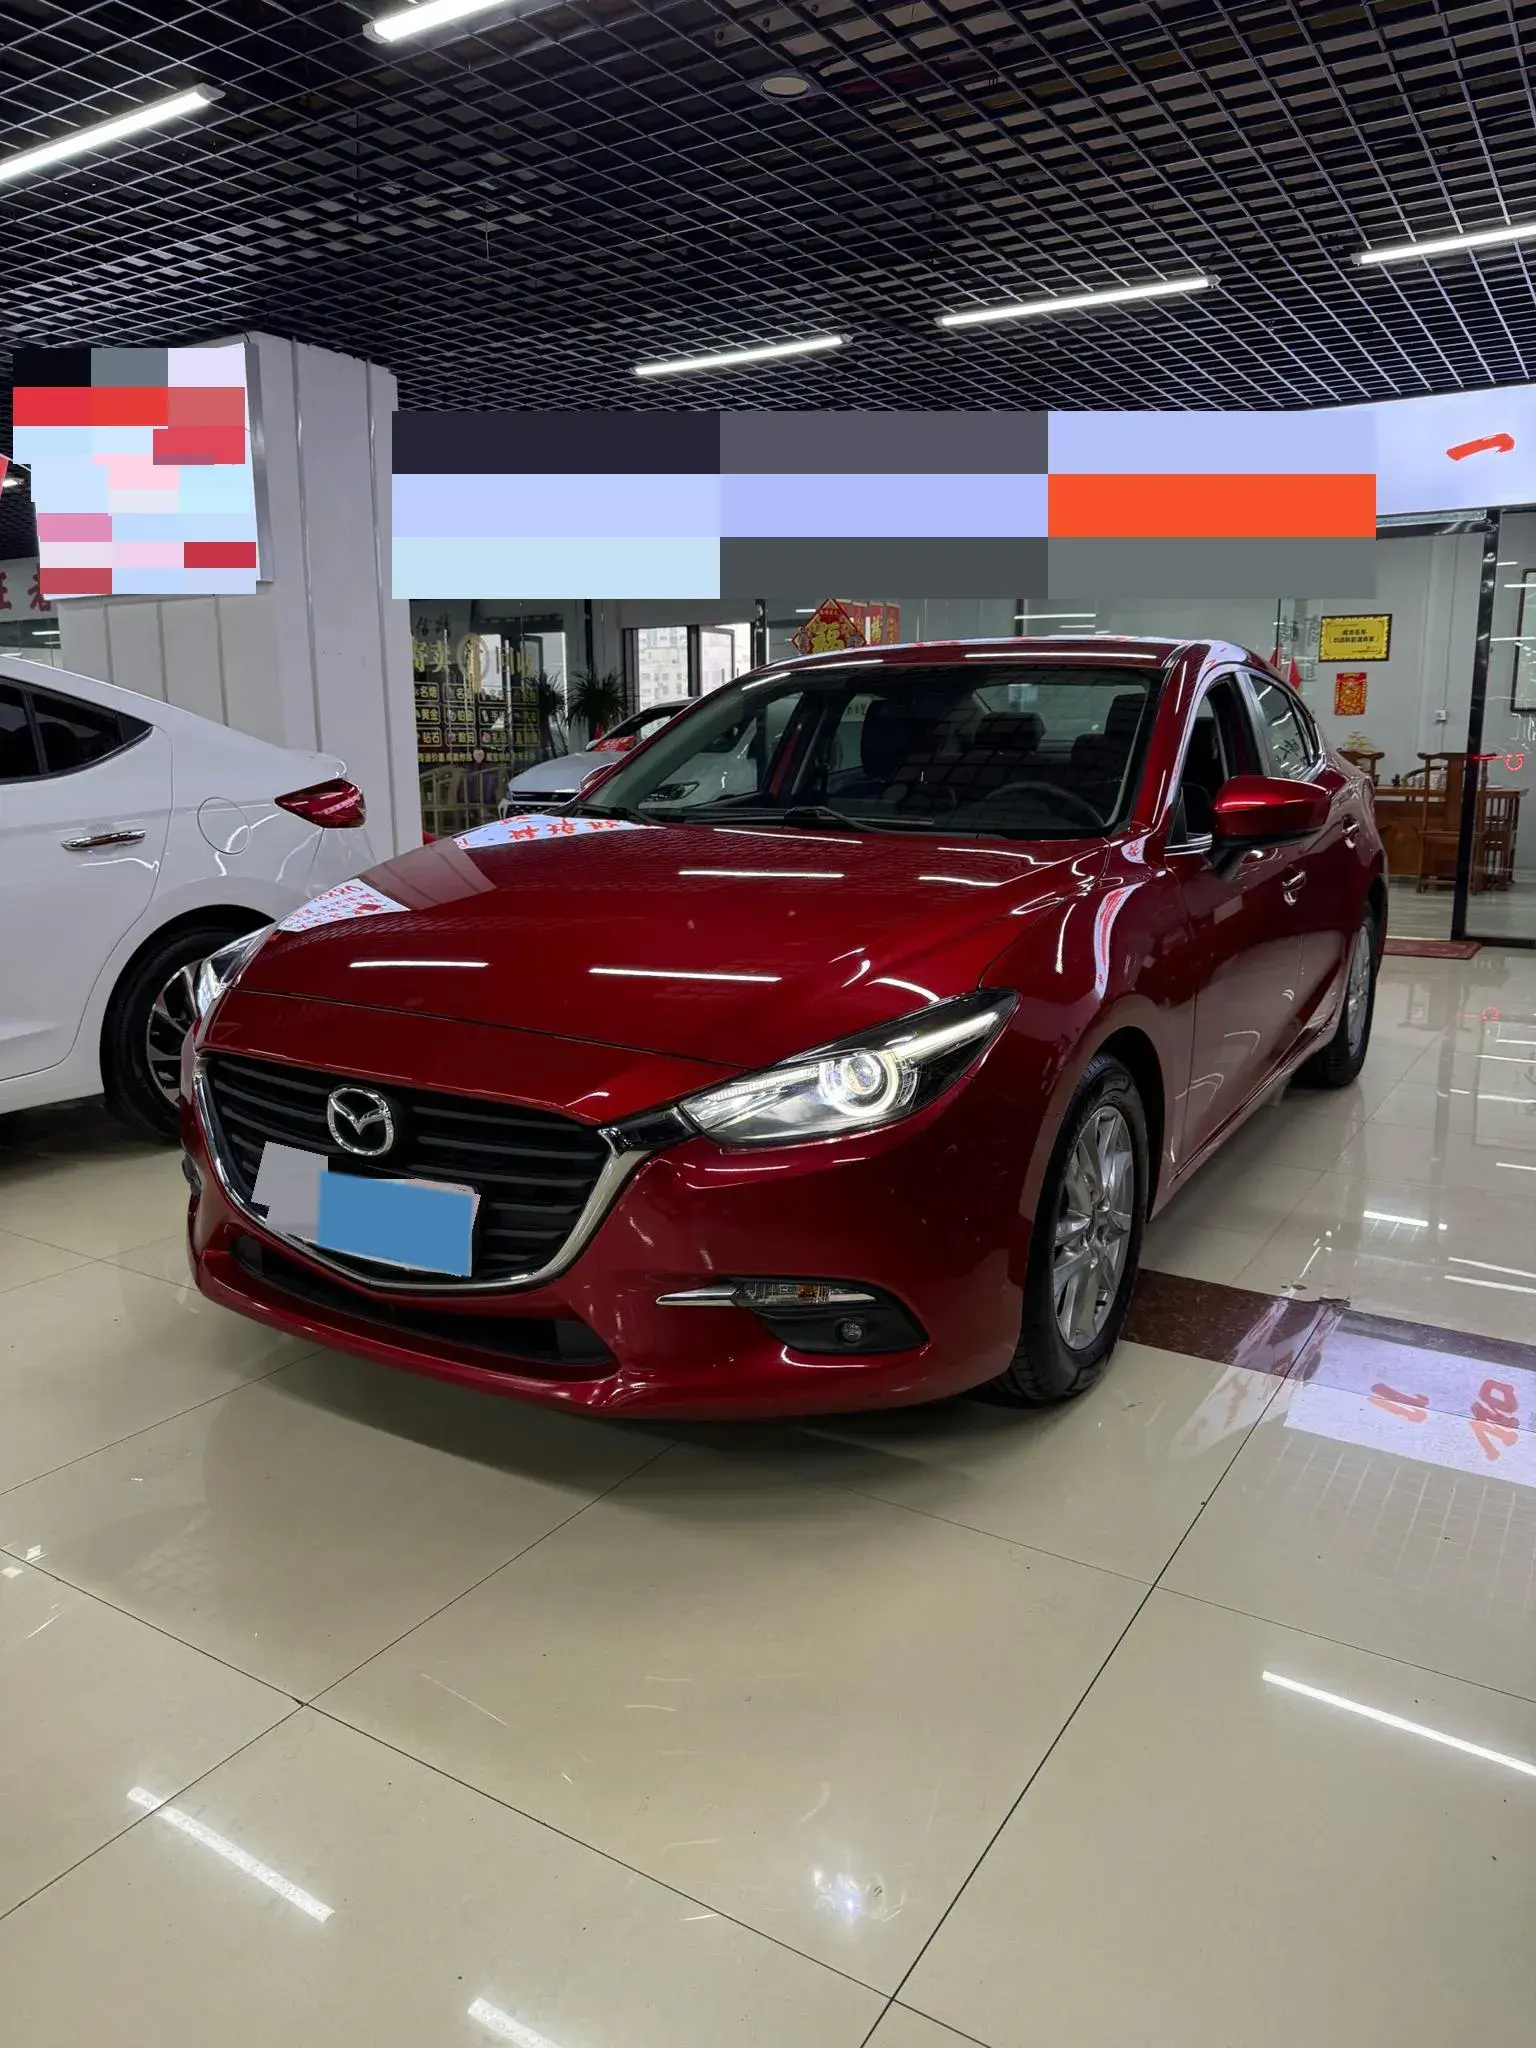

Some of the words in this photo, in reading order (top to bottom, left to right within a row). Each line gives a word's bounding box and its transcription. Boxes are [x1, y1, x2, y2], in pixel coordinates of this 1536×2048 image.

[812, 621, 845, 653] 福
[421, 708, 438, 721] 黄金
[422, 731, 440, 744] 钻石
